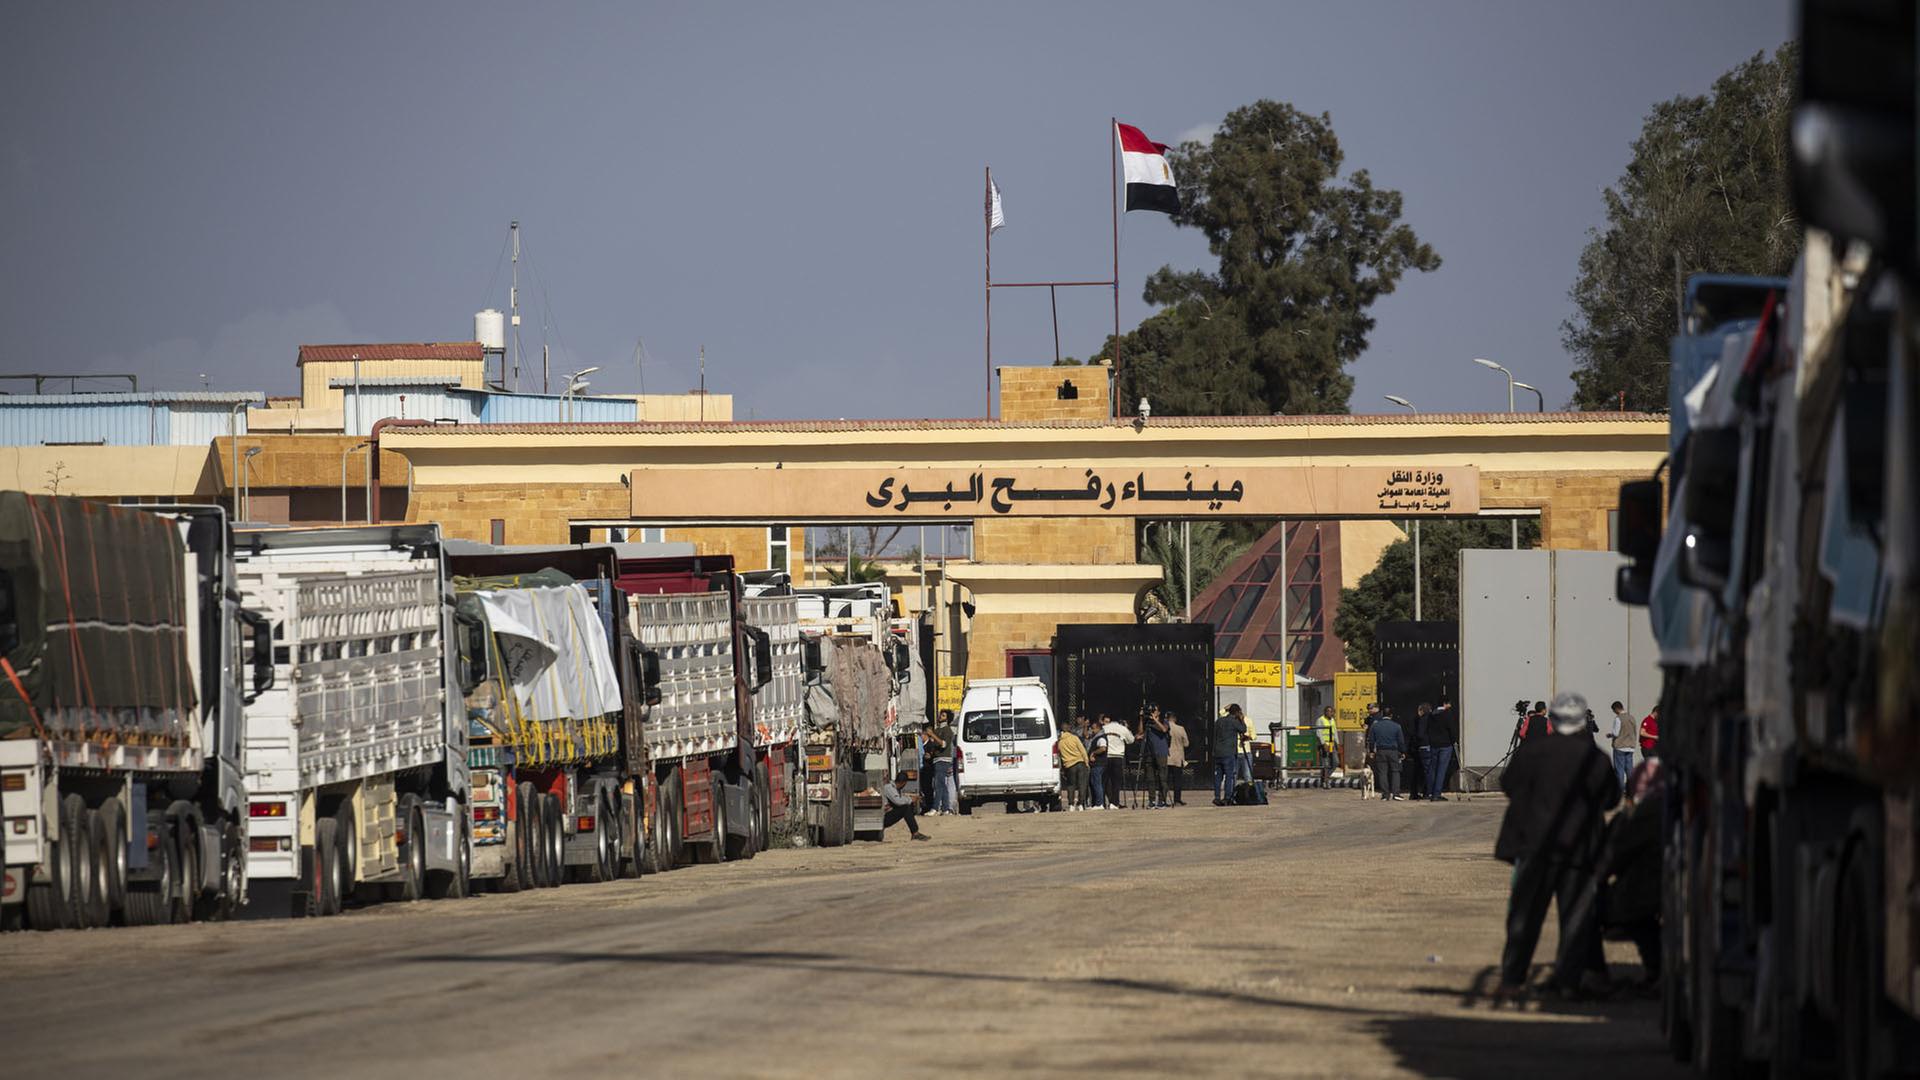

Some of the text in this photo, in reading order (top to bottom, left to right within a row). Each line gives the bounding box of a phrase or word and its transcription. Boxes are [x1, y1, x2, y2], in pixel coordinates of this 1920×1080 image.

[991, 468, 1116, 513] رفح
[1121, 471, 1244, 511] ميناء
[1386, 470, 1443, 486] وزارة النقل
[1252, 676, 1268, 684] Park
